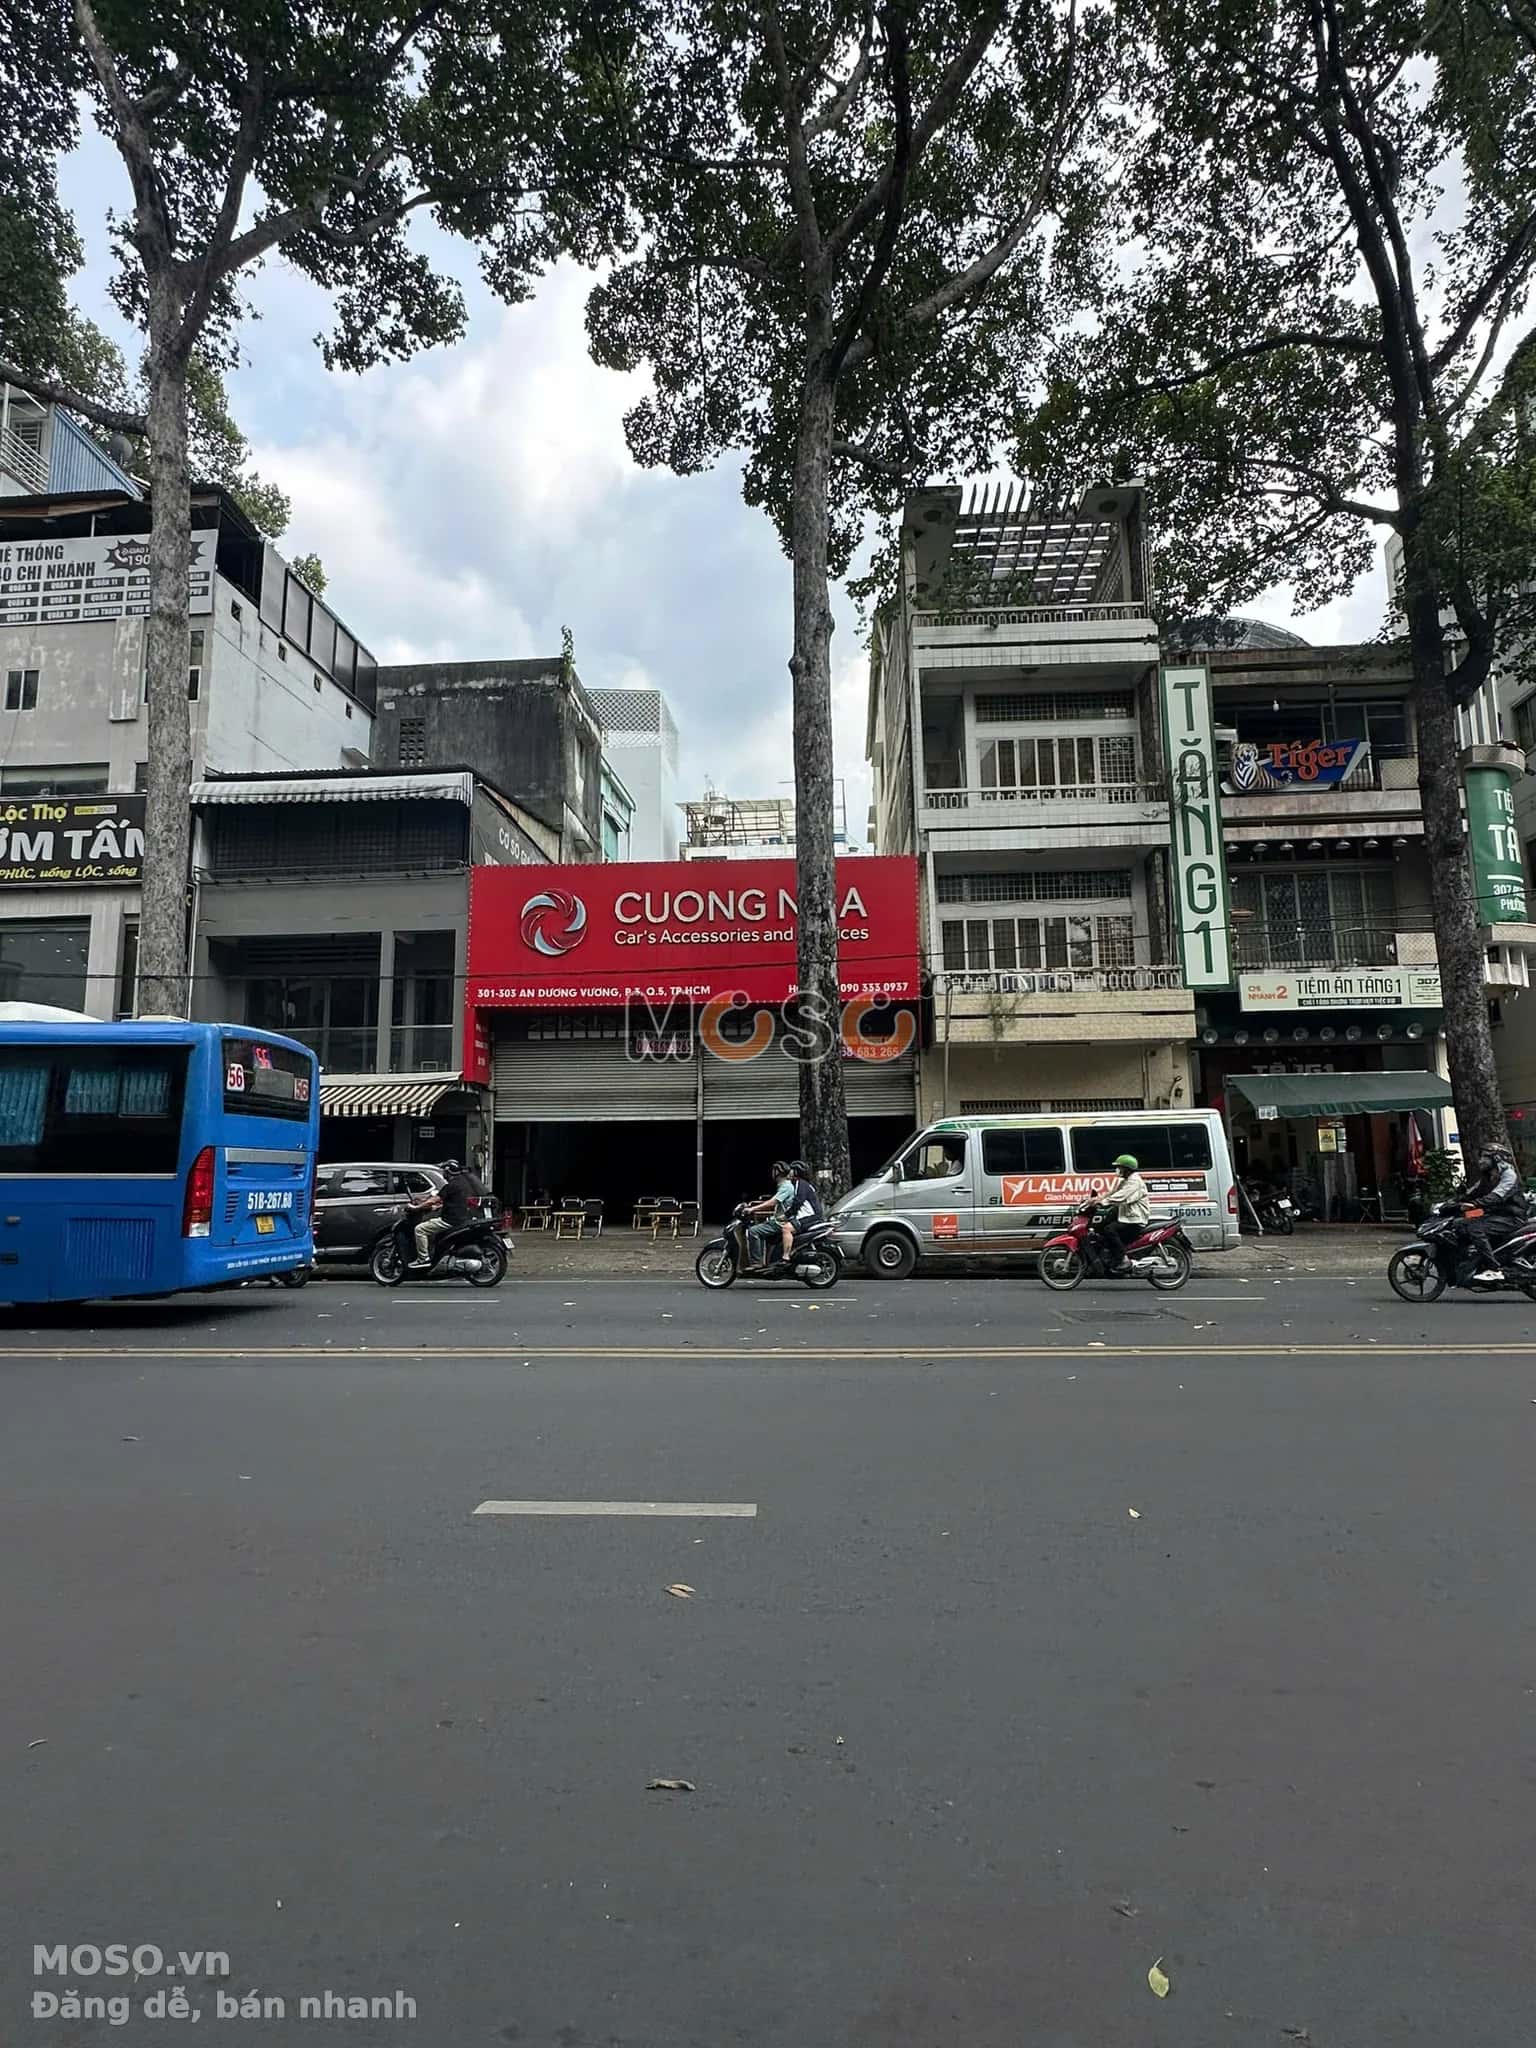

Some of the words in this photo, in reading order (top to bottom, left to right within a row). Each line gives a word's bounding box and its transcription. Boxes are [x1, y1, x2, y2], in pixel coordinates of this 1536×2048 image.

[16, 565, 42, 581] CHI
[1266, 738, 1351, 781] Tiger
[32, 803, 67, 823] Thọ
[613, 887, 765, 924] CUONG
[777, 886, 868, 920] NA
[614, 929, 657, 945] Car's
[659, 925, 760, 944] Accessories
[763, 926, 794, 942] and
[519, 988, 536, 997] AN
[840, 983, 859, 993] 090
[862, 983, 881, 992] 333
[883, 982, 909, 992] 0937
[1276, 985, 1288, 999] 2
[228, 1065, 243, 1088] 56
[296, 1078, 308, 1100] 56
